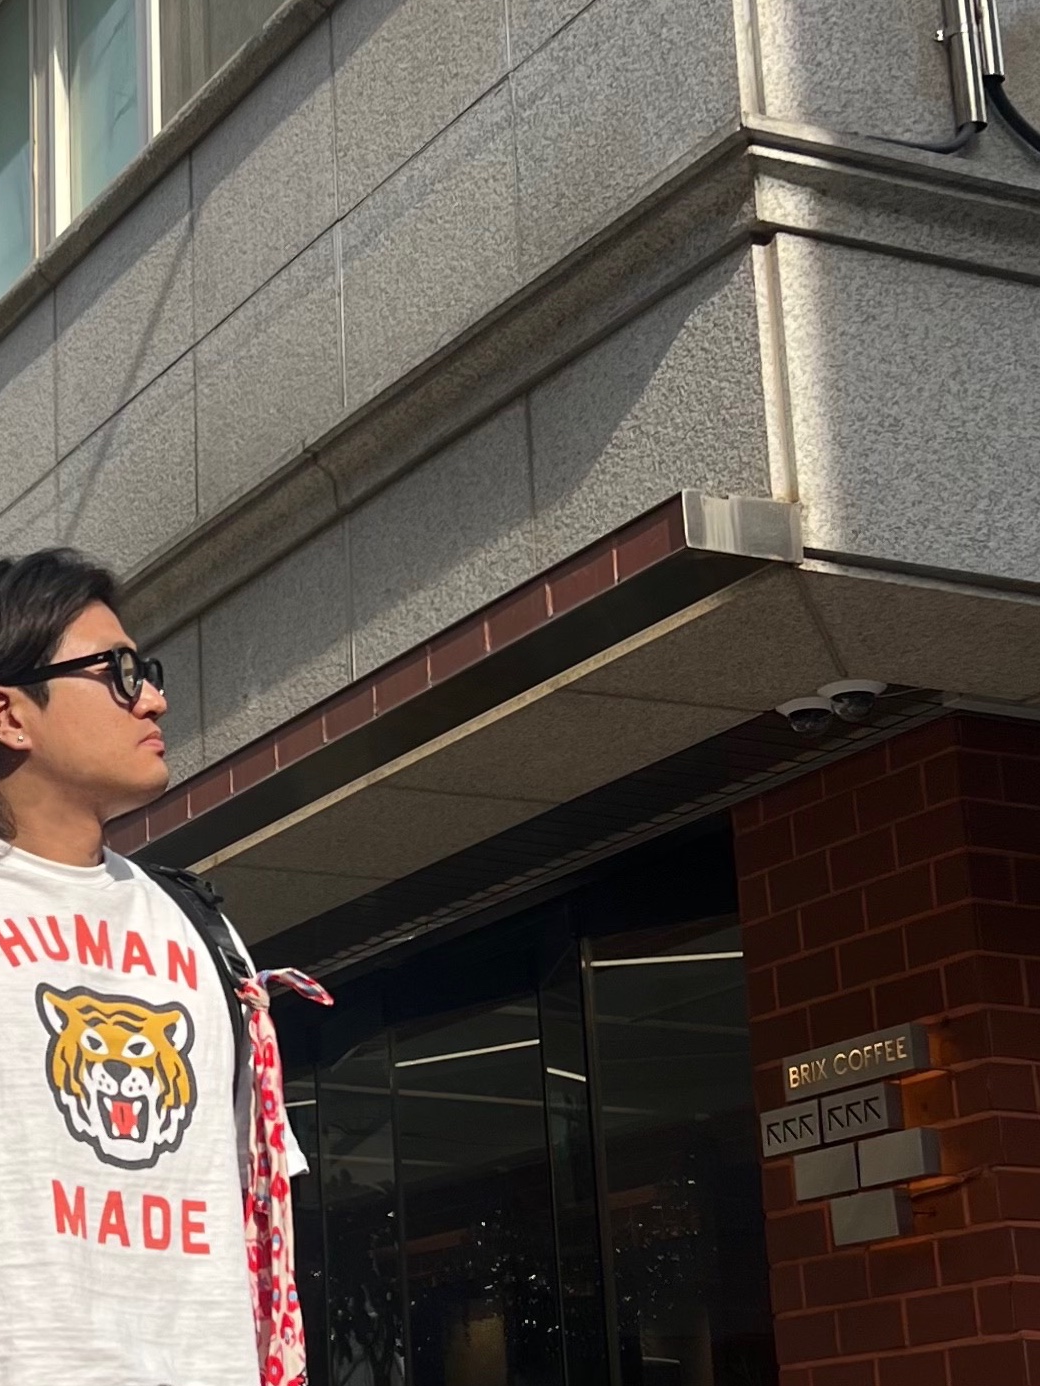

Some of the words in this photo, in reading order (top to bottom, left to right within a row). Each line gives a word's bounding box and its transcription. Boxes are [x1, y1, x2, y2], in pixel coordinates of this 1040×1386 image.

[788, 1058, 828, 1088] BRIX
[833, 1036, 907, 1075] COFFEE
[52, 1180, 210, 1255] MADE
